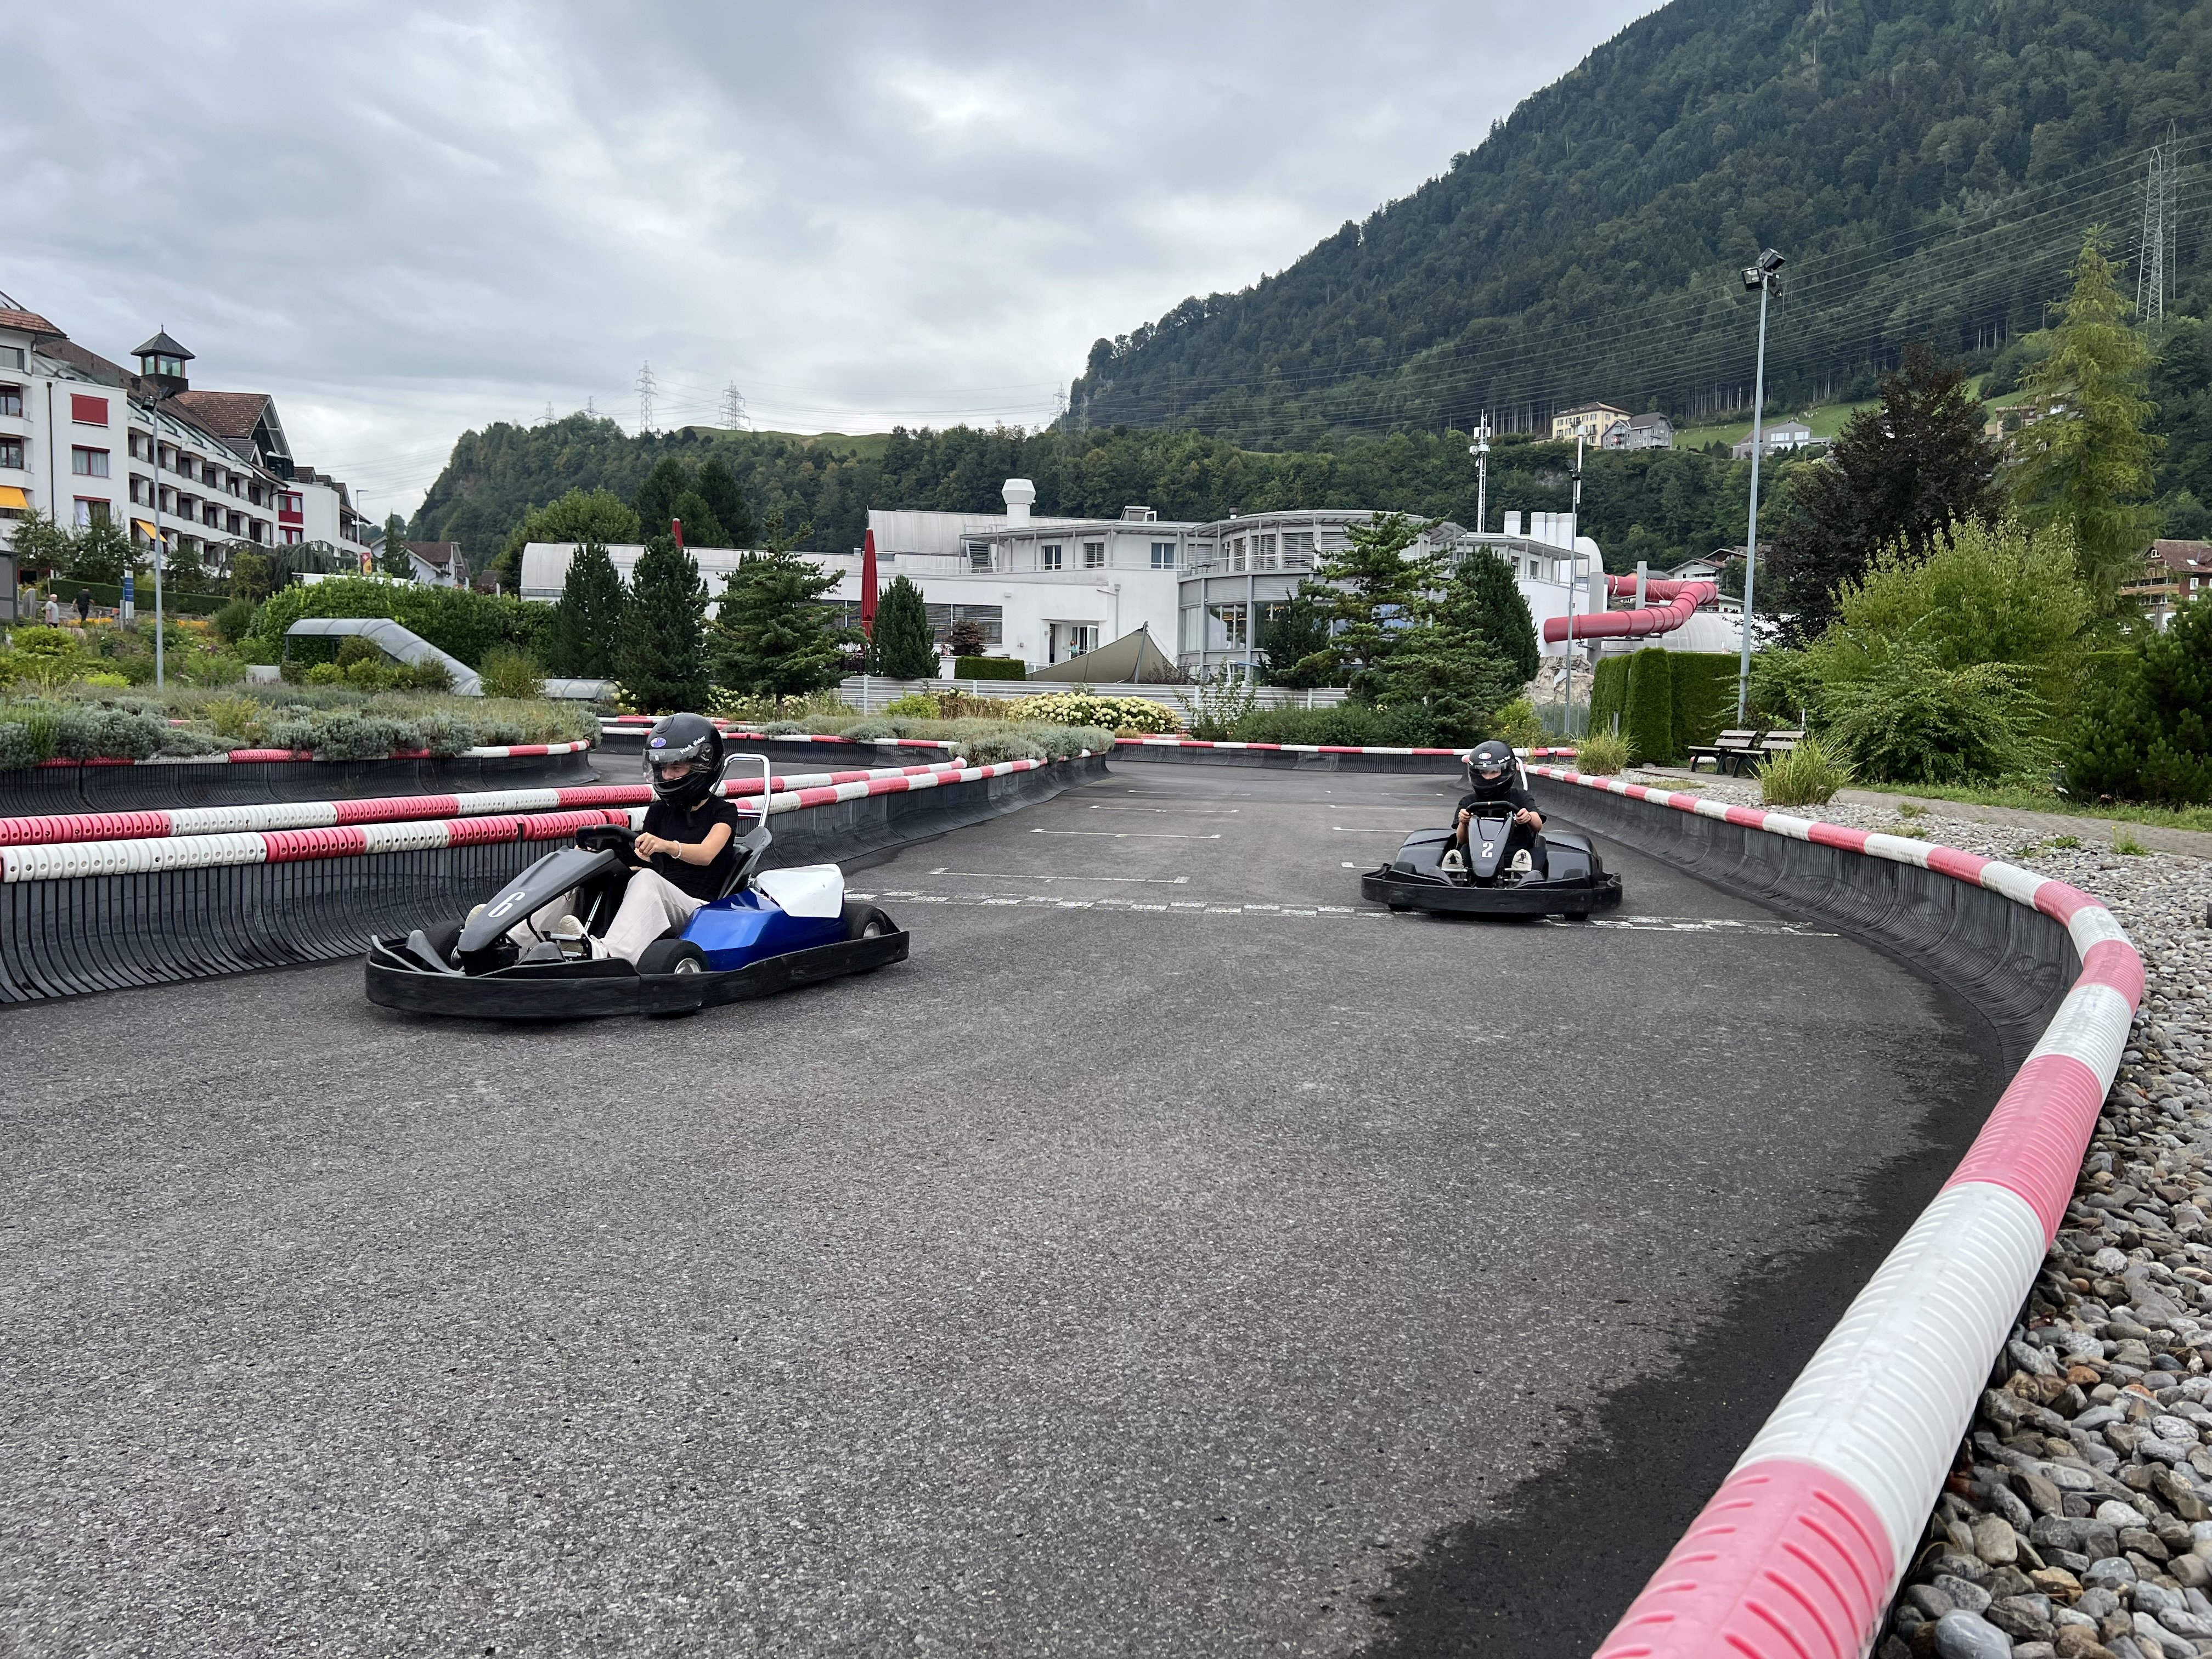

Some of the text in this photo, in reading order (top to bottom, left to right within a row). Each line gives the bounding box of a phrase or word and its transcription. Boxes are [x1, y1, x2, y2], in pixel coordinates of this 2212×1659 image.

[680, 744, 693, 754] Mark
[1481, 842, 1493, 858] 2
[488, 891, 526, 918] 6
